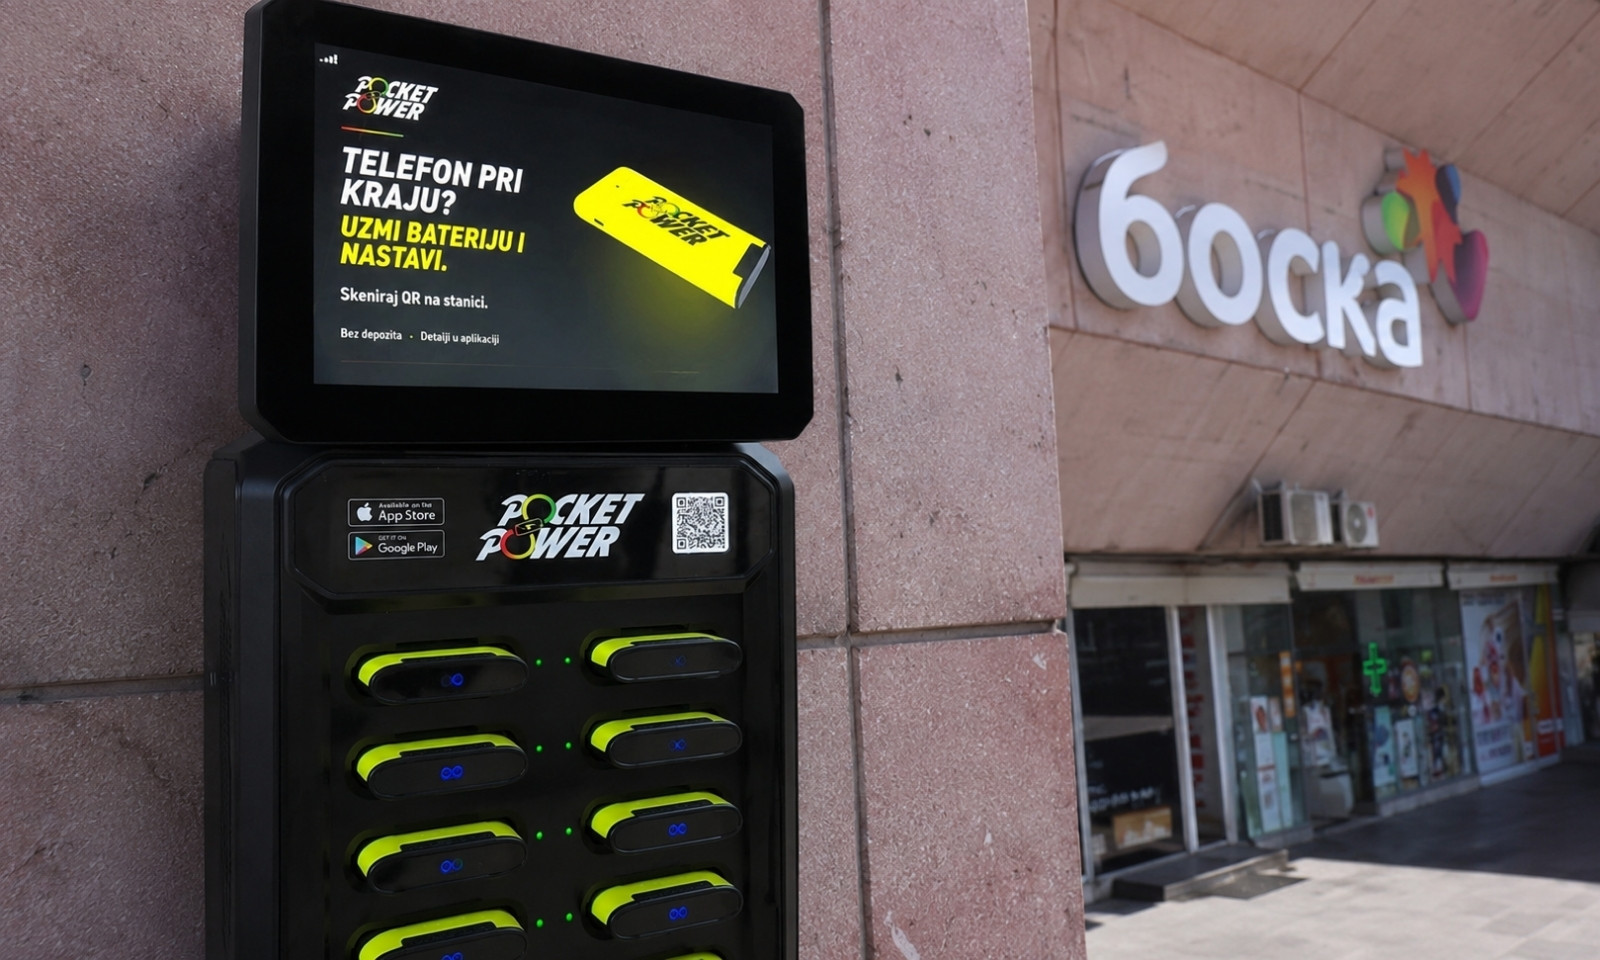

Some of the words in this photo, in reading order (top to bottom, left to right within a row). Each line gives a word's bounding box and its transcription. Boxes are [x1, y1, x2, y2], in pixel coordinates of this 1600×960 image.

[355, 76, 439, 105] POCKET
[342, 92, 425, 121] POWER
[342, 146, 473, 188] TELEFON
[478, 164, 524, 194] PRI
[340, 178, 457, 216] KRAJU?
[340, 215, 402, 242] UZMI
[406, 221, 514, 252] BATERIJU
[517, 232, 526, 254] I
[340, 242, 448, 272] NASTAVI.
[1098, 140, 1423, 368] боска
[340, 286, 398, 308] Skeniraj
[401, 290, 421, 306] QR
[424, 294, 441, 306] na
[443, 293, 489, 310] stanici.
[340, 327, 359, 340] Bez
[361, 328, 403, 342] depozita
[452, 334, 459, 342] u
[460, 332, 500, 346] aplikaciji
[378, 510, 403, 524] App
[405, 509, 436, 521] Store
[497, 493, 645, 527] POCKET
[378, 542, 415, 555] Google
[417, 541, 438, 554] Play
[475, 527, 621, 562] POWER
